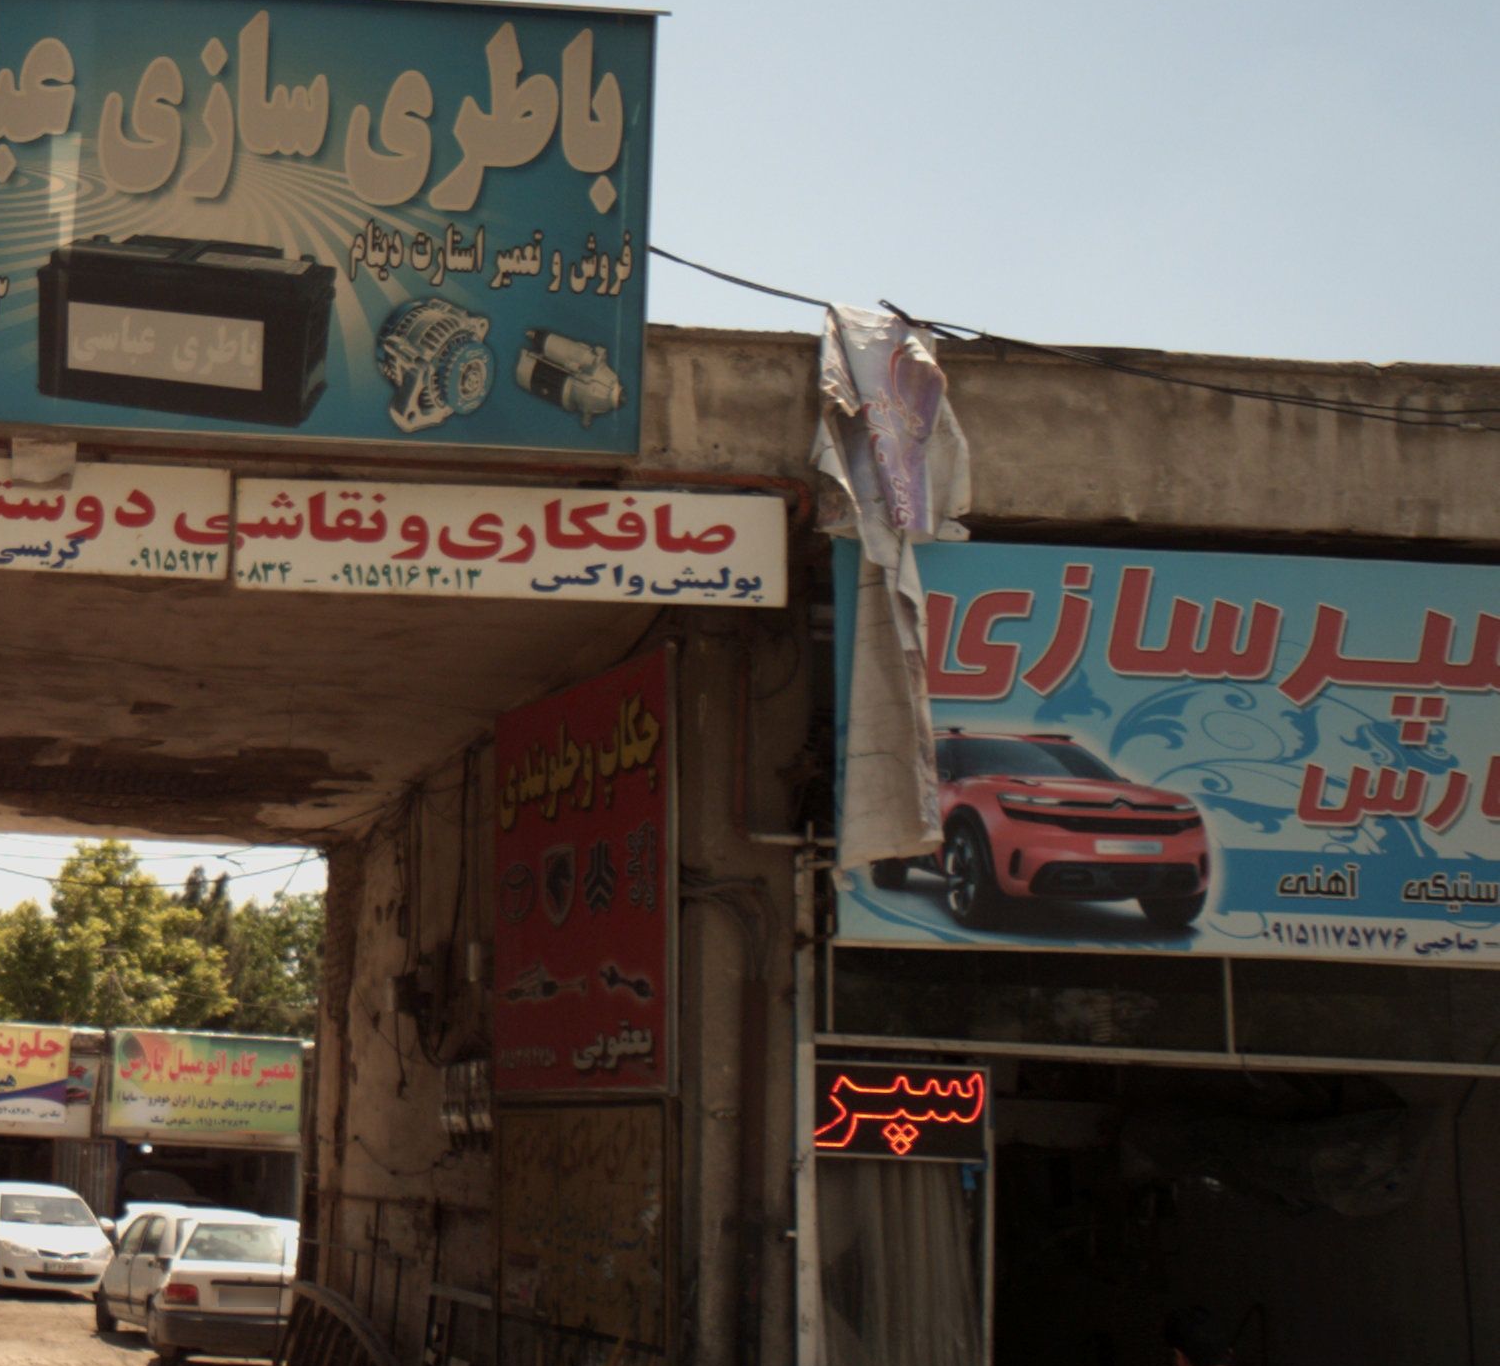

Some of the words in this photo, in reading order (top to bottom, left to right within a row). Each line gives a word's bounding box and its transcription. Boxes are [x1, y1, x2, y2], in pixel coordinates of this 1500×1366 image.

[100, 10, 330, 201] سازی
[343, 21, 624, 214] باطری
[349, 217, 404, 282] دینام
[409, 223, 485, 287] استارت
[489, 229, 544, 290] تعمیر
[548, 248, 563, 292] و
[569, 229, 633, 296] فروش
[437, 499, 736, 563] صافکاری
[648, 568, 763, 604] پولیش
[1278, 864, 1361, 901] آهنی
[1413, 931, 1480, 955] صاحبی
[572, 1019, 653, 1072] یعقوبی
[814, 1073, 986, 1154] سپر
